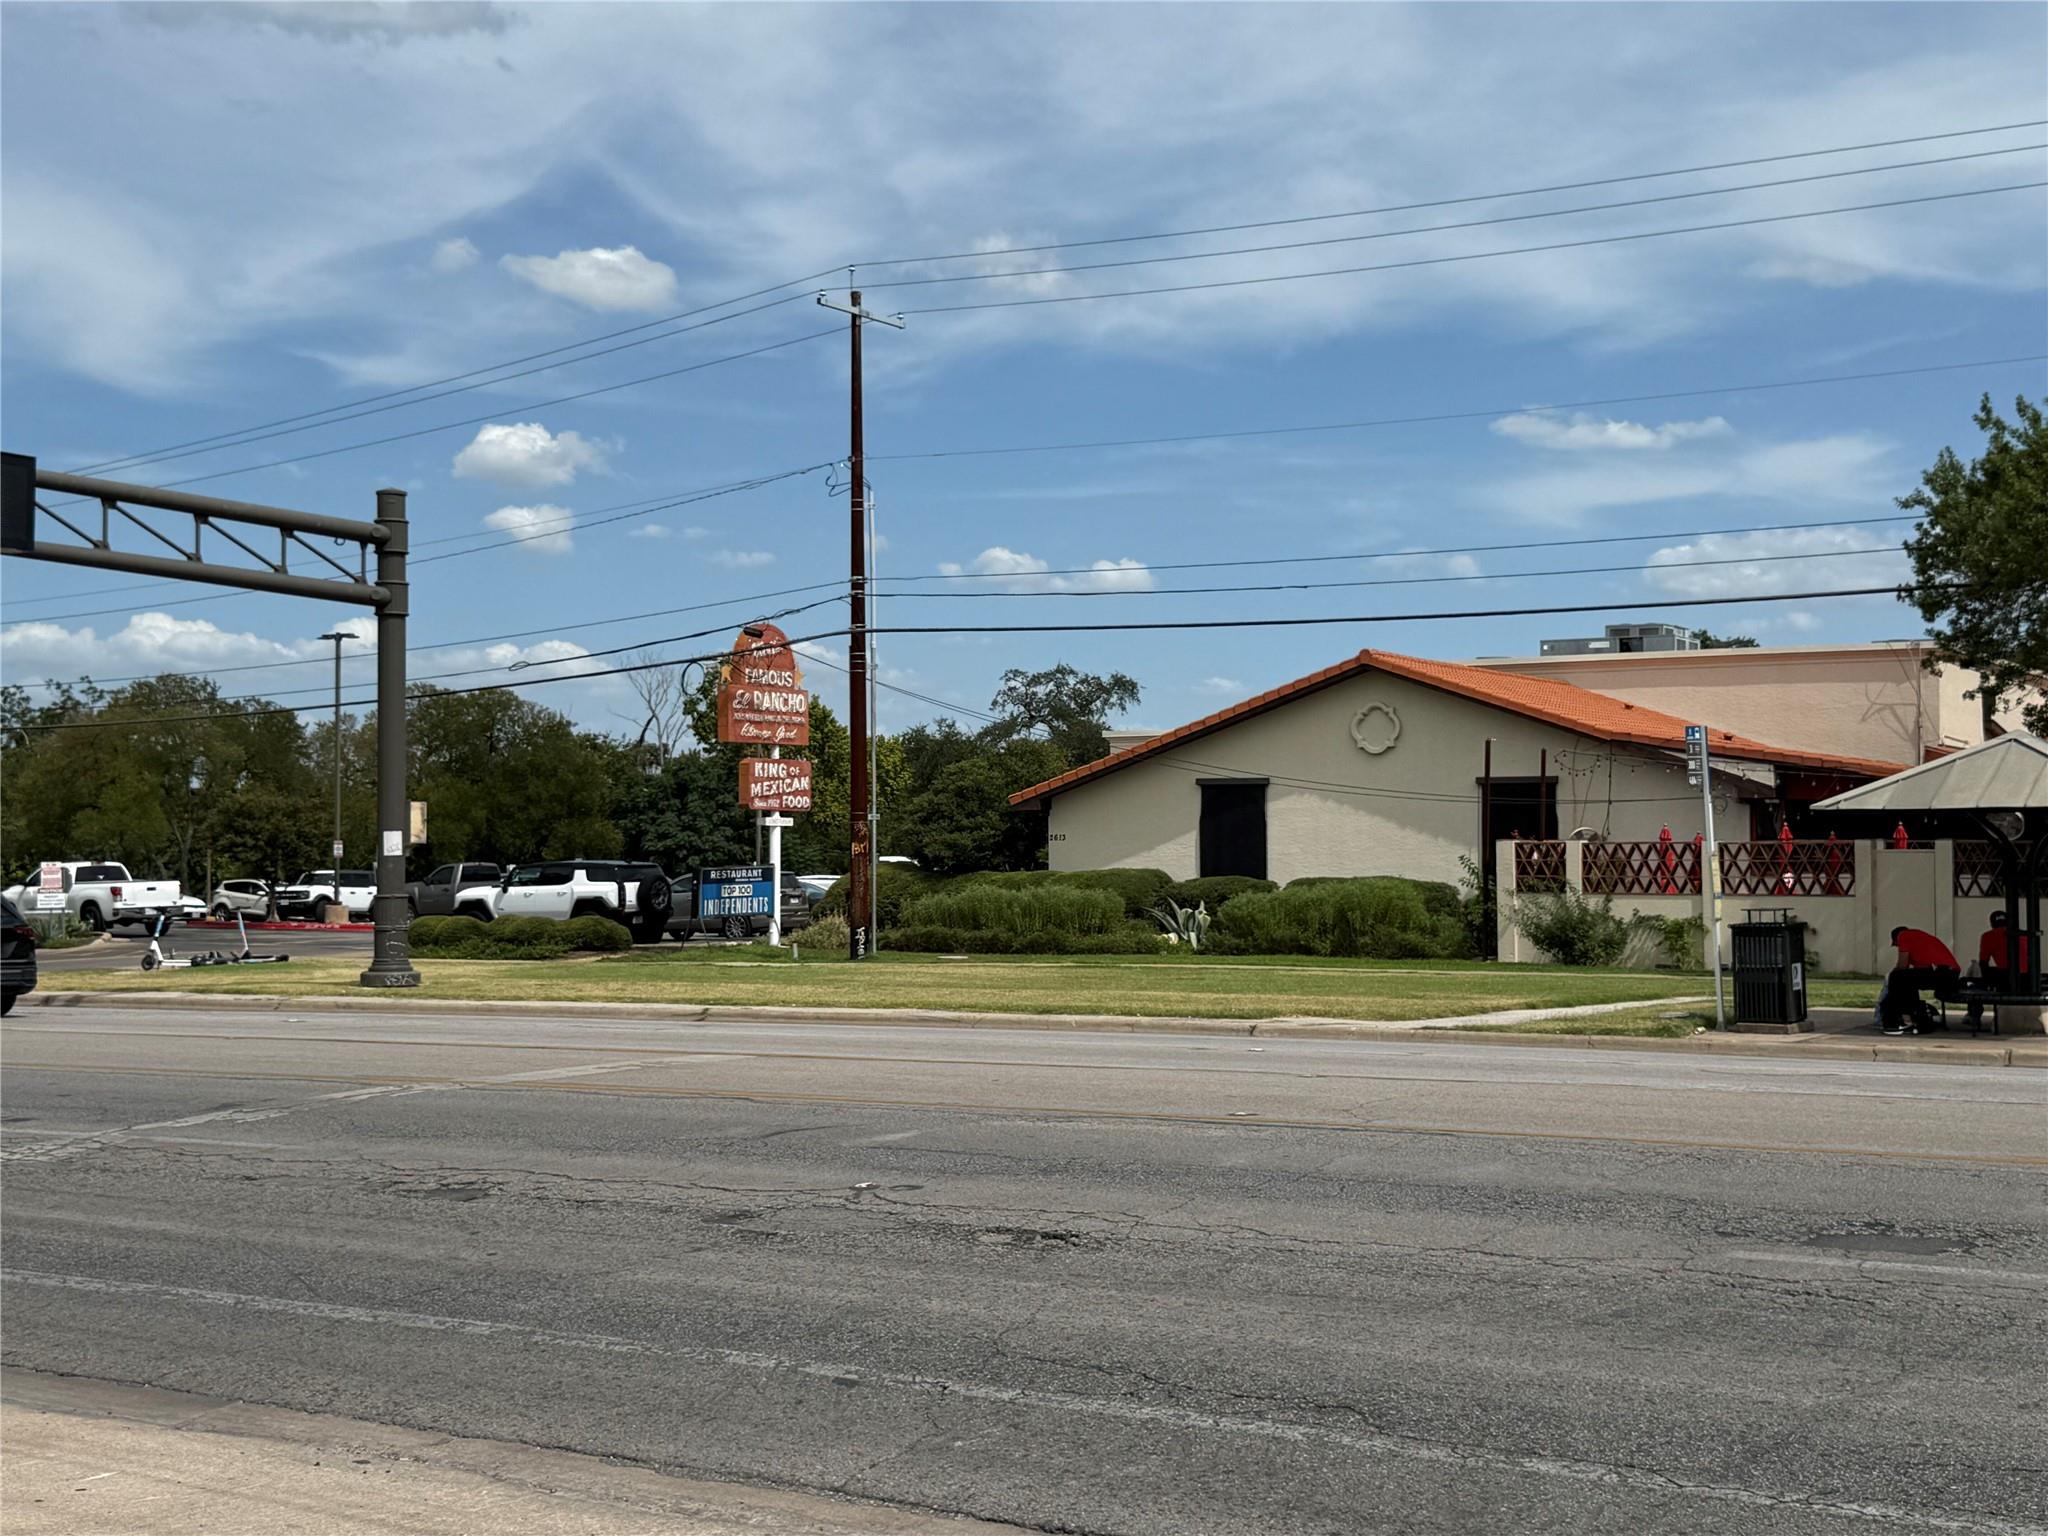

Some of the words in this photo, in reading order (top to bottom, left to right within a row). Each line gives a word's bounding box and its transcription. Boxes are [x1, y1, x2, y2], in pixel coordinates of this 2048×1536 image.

[745, 668, 793, 687] FAMOUS
[733, 689, 751, 709] El
[753, 691, 806, 713] RANCHO
[755, 762, 787, 778] KING
[789, 766, 801, 775] OF
[751, 776, 810, 797] MEXICAN
[782, 795, 810, 809] FOOD
[710, 869, 762, 879] RESTAURANT
[722, 886, 736, 895] TOP
[738, 885, 752, 894] 100
[704, 897, 769, 916] INDEPENDENTS
